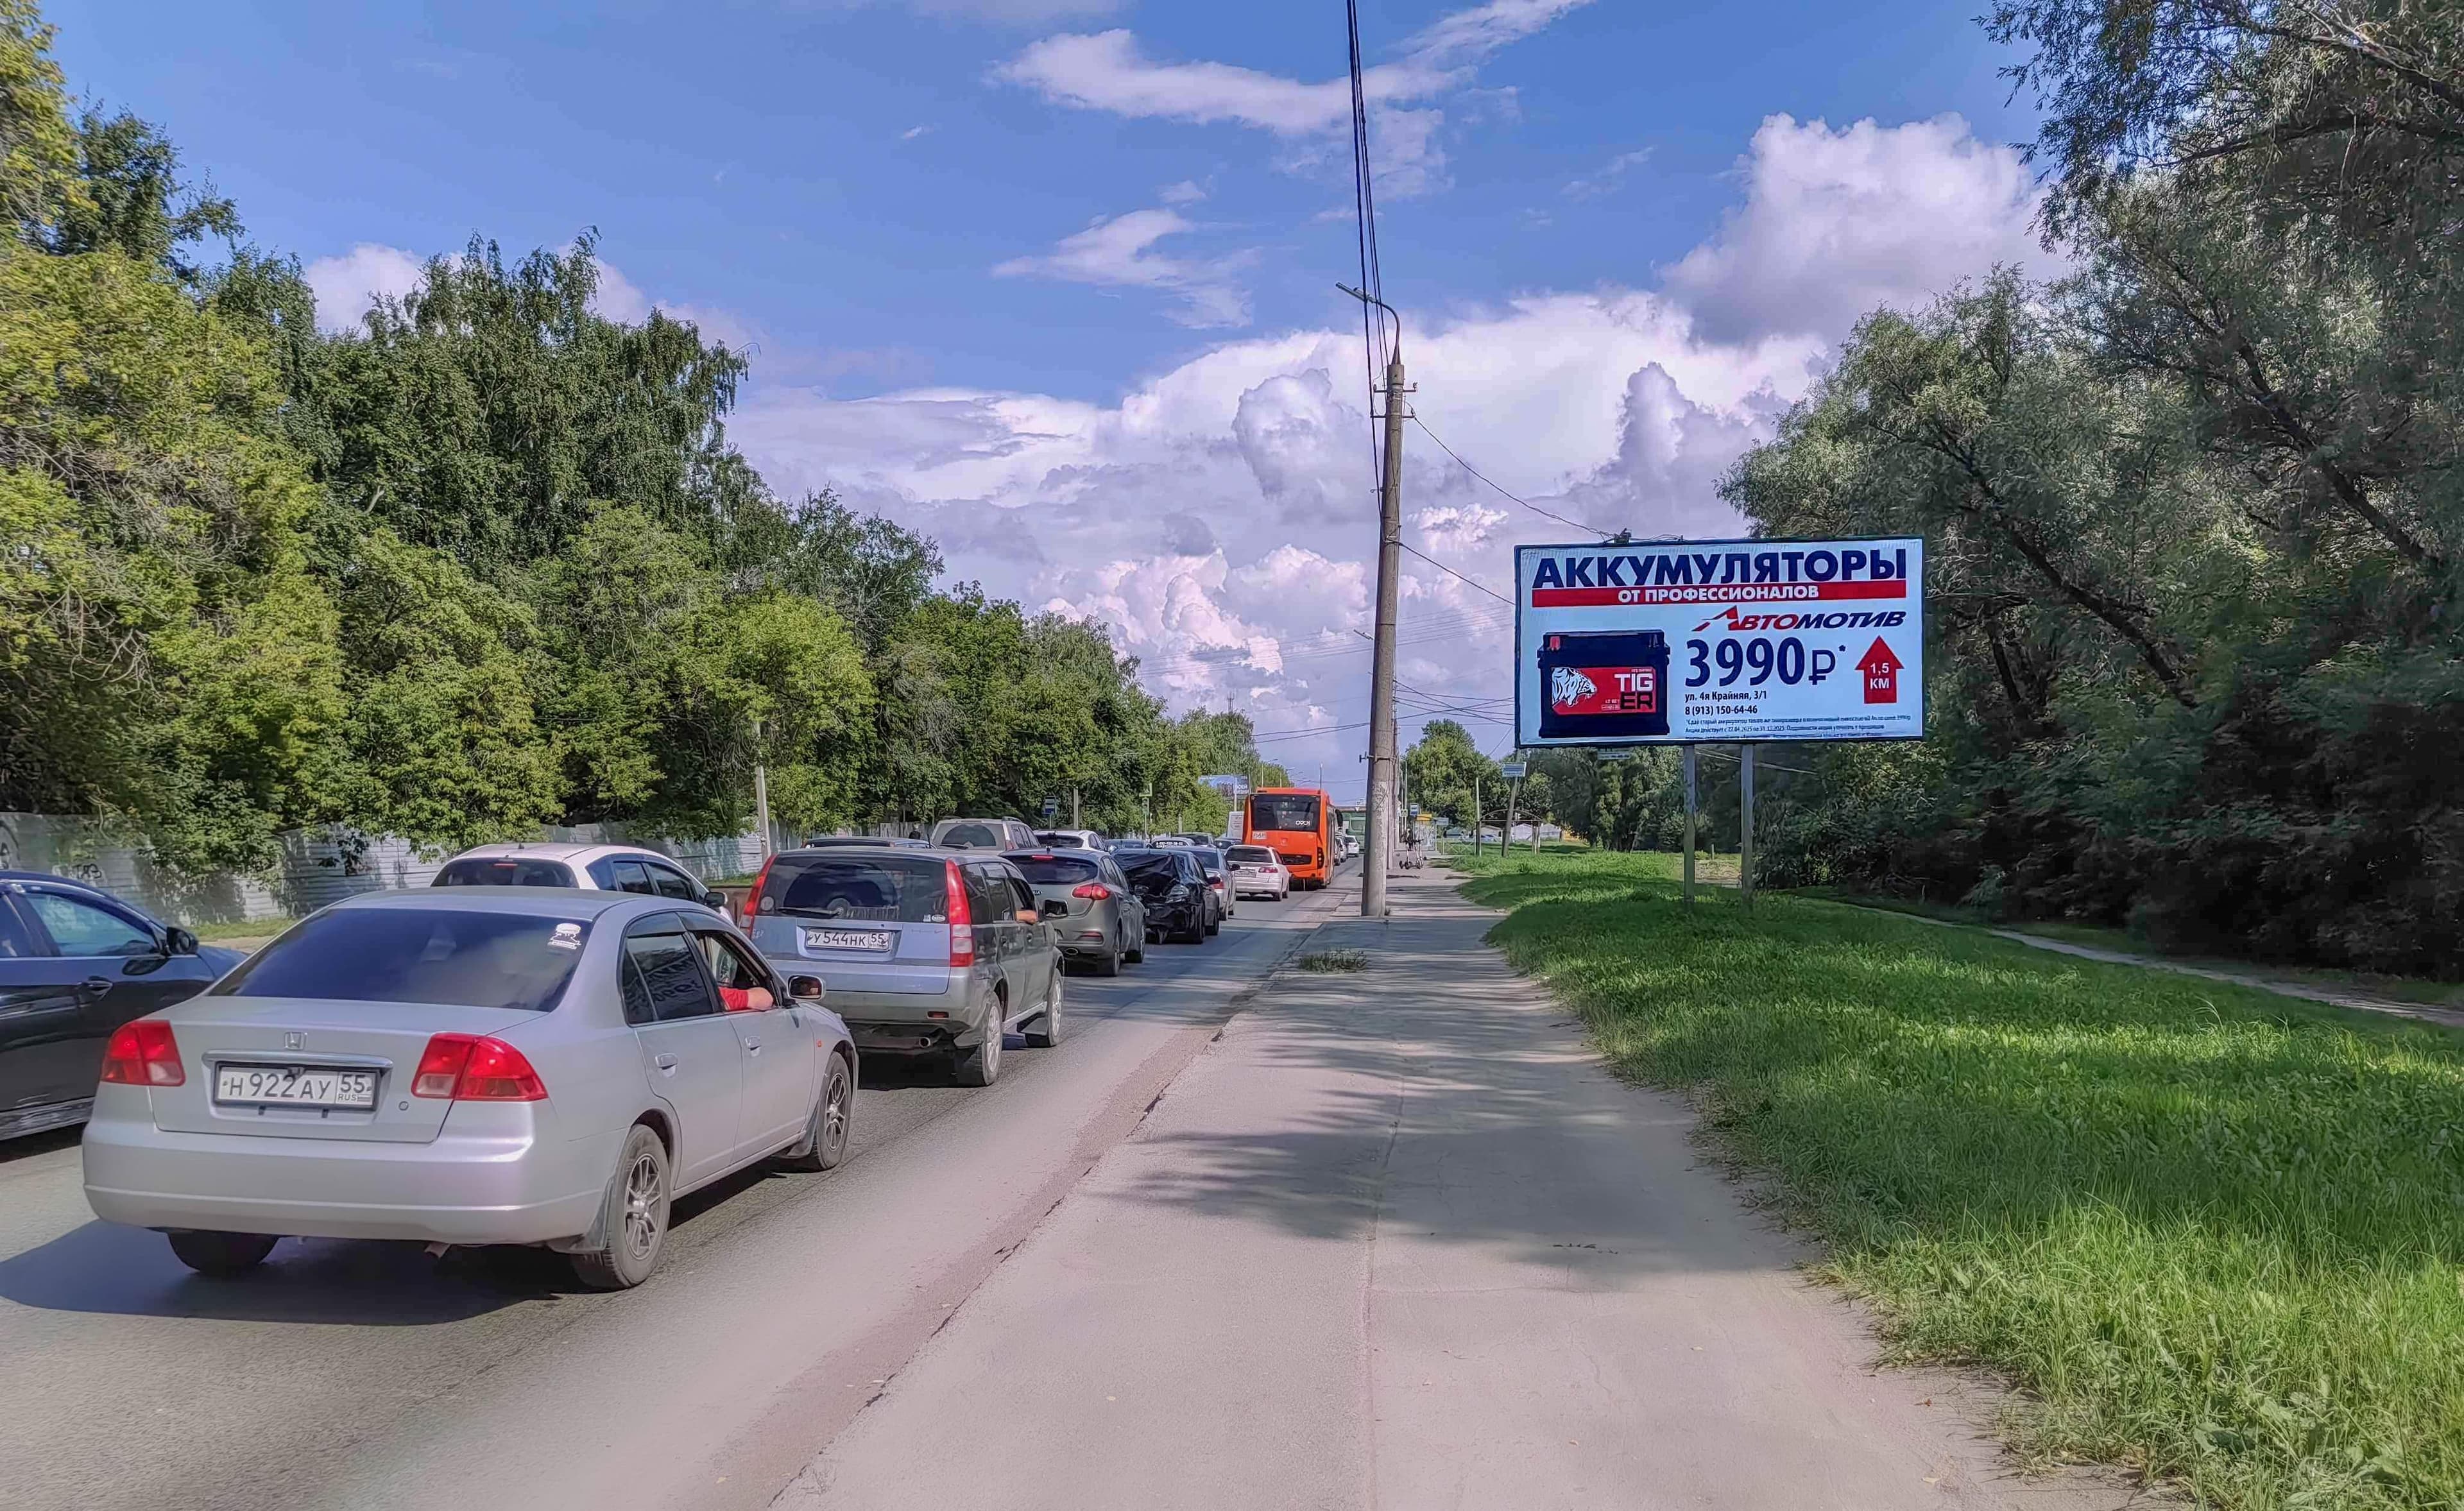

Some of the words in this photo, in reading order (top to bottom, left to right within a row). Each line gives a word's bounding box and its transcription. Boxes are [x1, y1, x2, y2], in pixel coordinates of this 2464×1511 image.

[1532, 549, 1906, 589] АККУМУЛЯТОРЫ
[1618, 589, 1641, 603] ОТ
[1645, 585, 1819, 602] ПРОФЕССИОНАЛОВ
[1870, 662, 1890, 674] 1,5
[1614, 673, 1654, 692] TIG
[1870, 678, 1890, 690] КМ
[1620, 692, 1654, 710] ER
[1685, 694, 1697, 703] ул.
[1700, 692, 1710, 701] 4я
[1712, 691, 1752, 702] Крайняя,
[1754, 690, 1767, 700] 3/1
[1685, 706, 1690, 715] 8
[1692, 706, 1714, 716] (913)
[1716, 704, 1758, 715] 150-64-46
[229, 1073, 331, 1100] Н922АУ
[340, 1074, 366, 1093] 55
